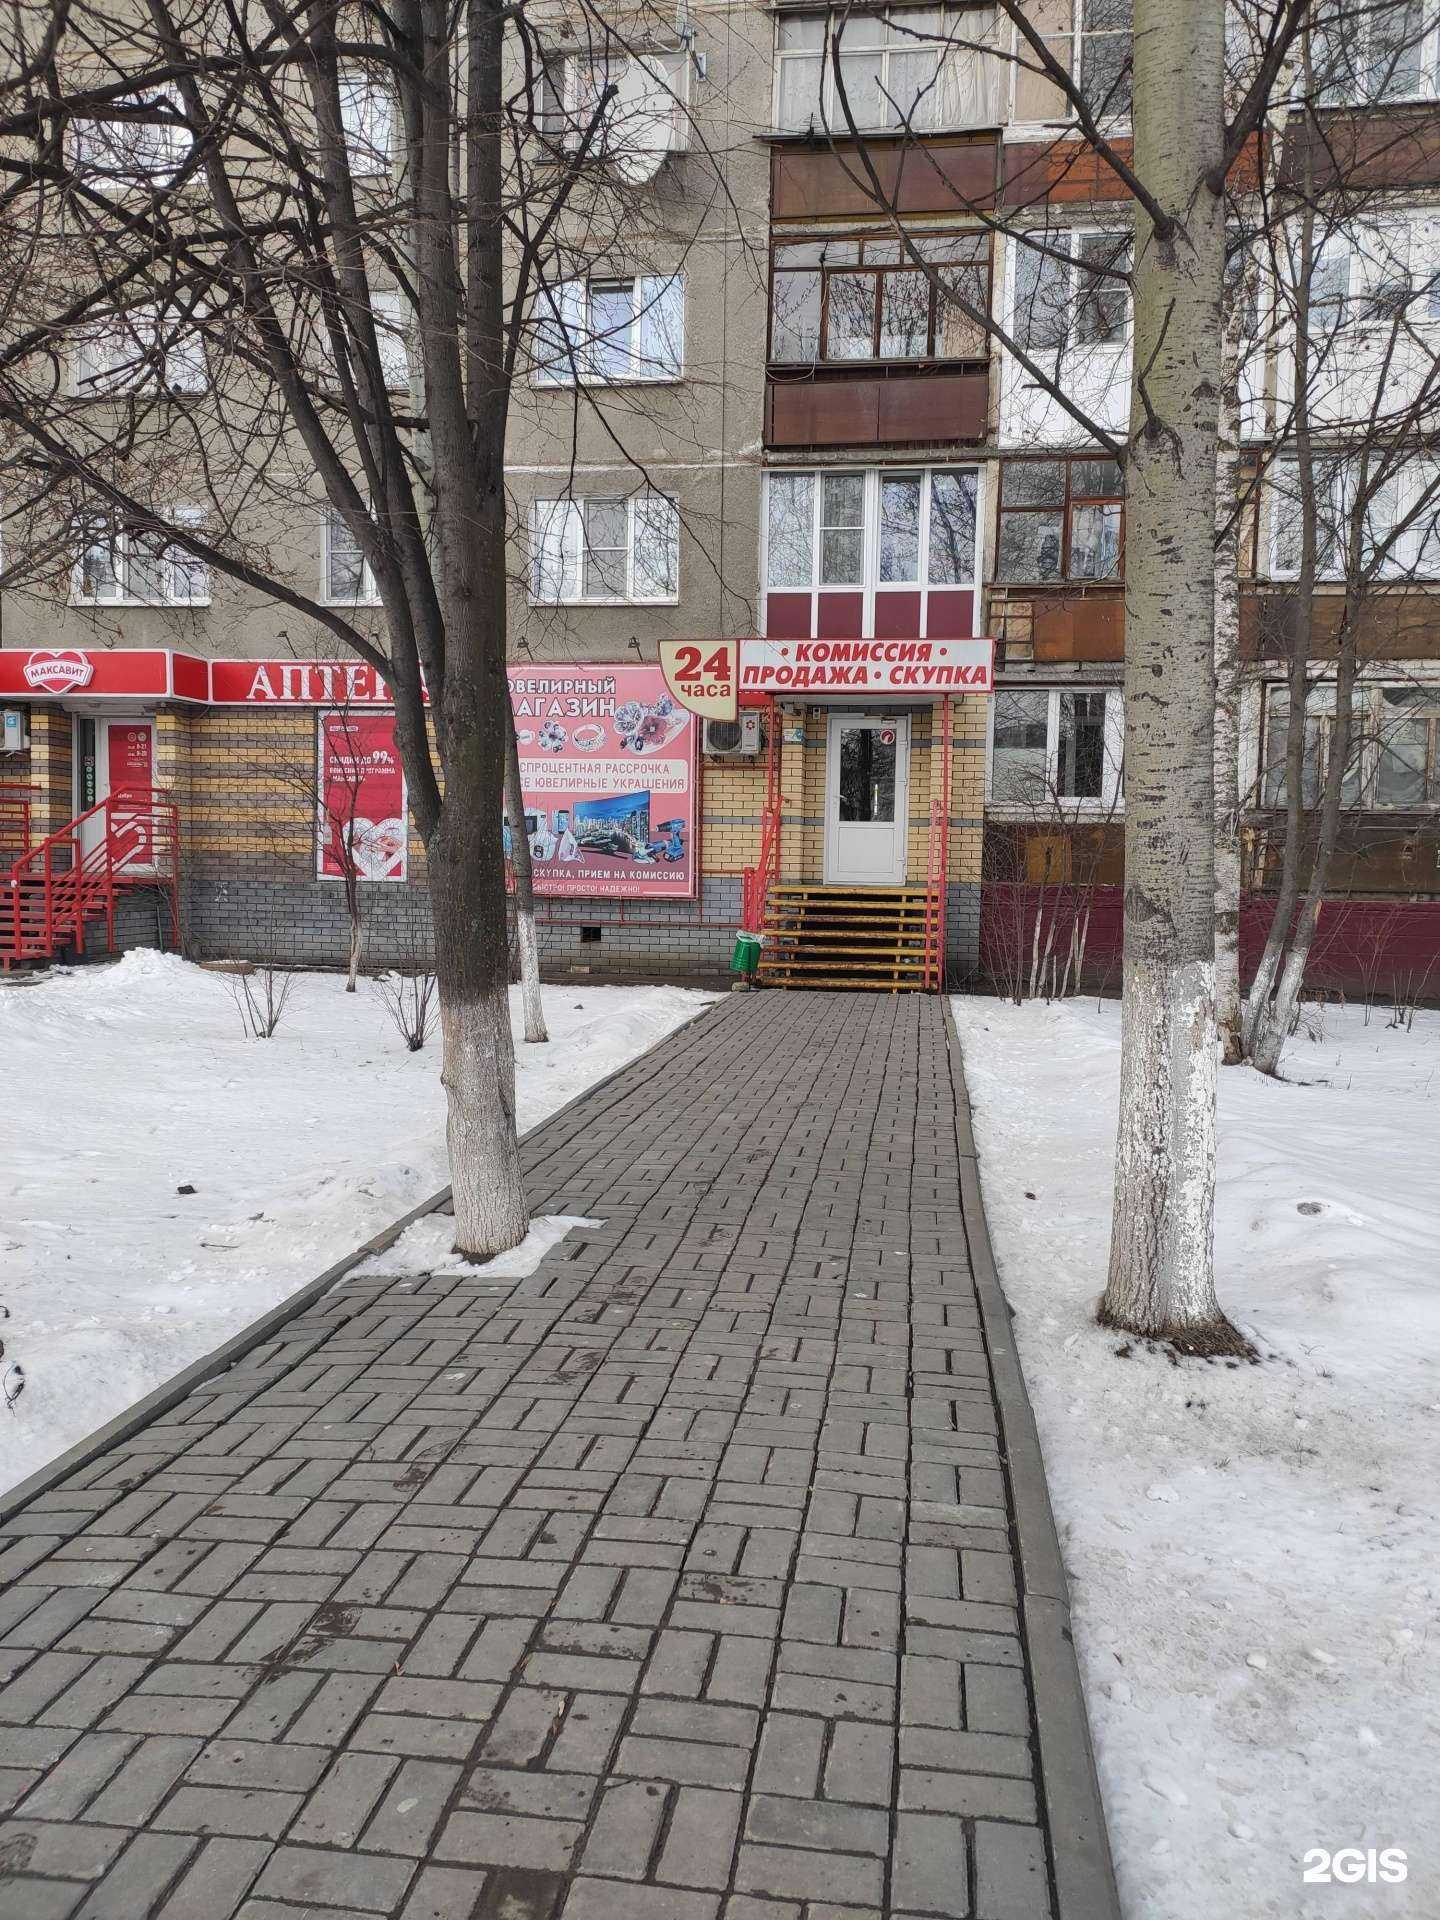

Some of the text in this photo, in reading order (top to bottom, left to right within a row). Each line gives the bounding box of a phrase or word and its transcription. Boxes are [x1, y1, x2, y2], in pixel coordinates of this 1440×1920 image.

[795, 643, 932, 662] КОМИССИЯ
[674, 646, 731, 681] 24
[30, 665, 84, 678] МАКСАВИТ
[743, 666, 987, 687] ПРОДАЖА СКУПКА
[680, 684, 731, 697] часа
[513, 697, 617, 717] АГАЗИН
[520, 762, 670, 775] СПРОЦЕНТНАЯ РАССРОЧКА
[535, 777, 607, 789] ЮВЕЛИРНЫЕ
[612, 778, 685, 789] УКРАШЕНИЯ
[578, 869, 611, 880] ПРИЕМ
[614, 870, 626, 880] НА
[630, 870, 685, 881] КОМИССИЮ
